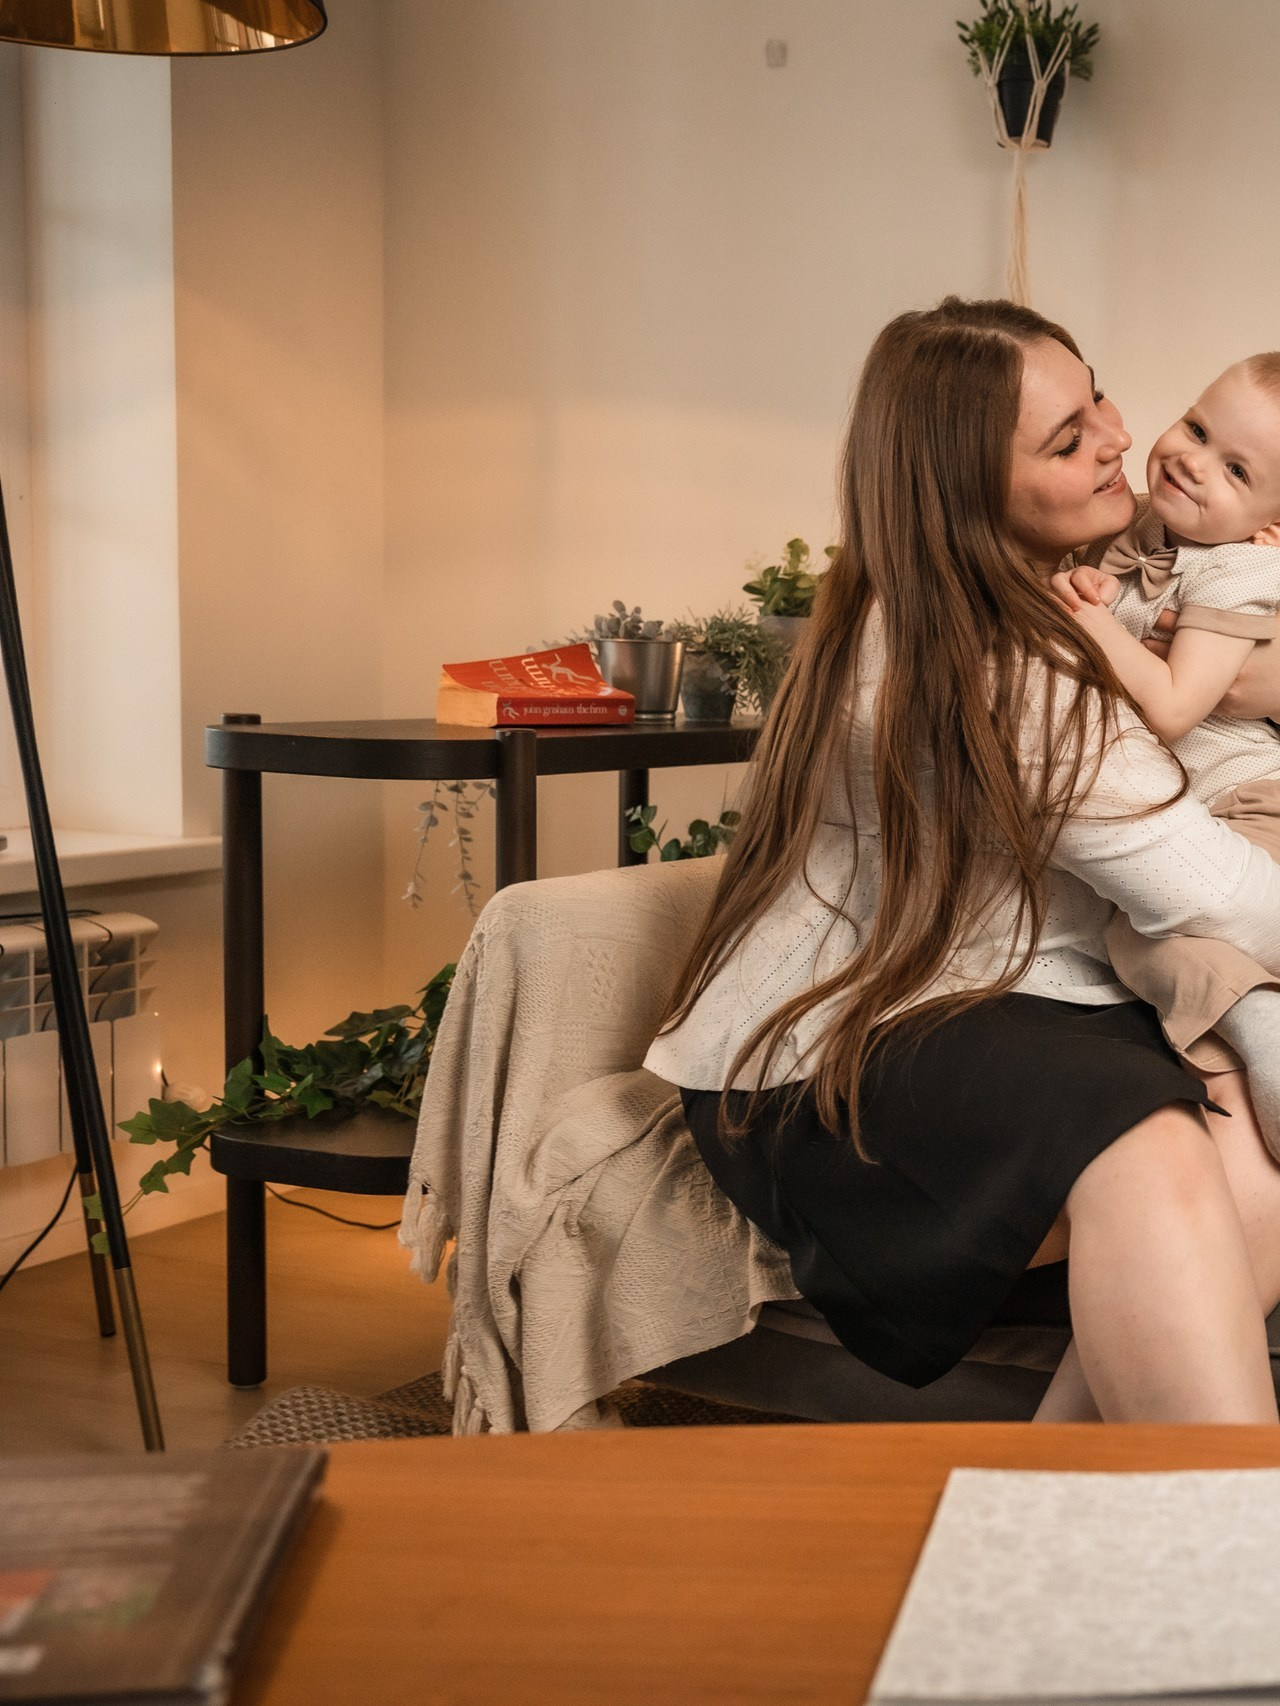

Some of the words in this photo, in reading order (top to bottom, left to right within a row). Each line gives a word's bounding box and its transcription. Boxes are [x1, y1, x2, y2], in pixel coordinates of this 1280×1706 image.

[542, 703, 575, 717] grisham
[576, 703, 589, 714] the
[589, 703, 608, 714] firm
